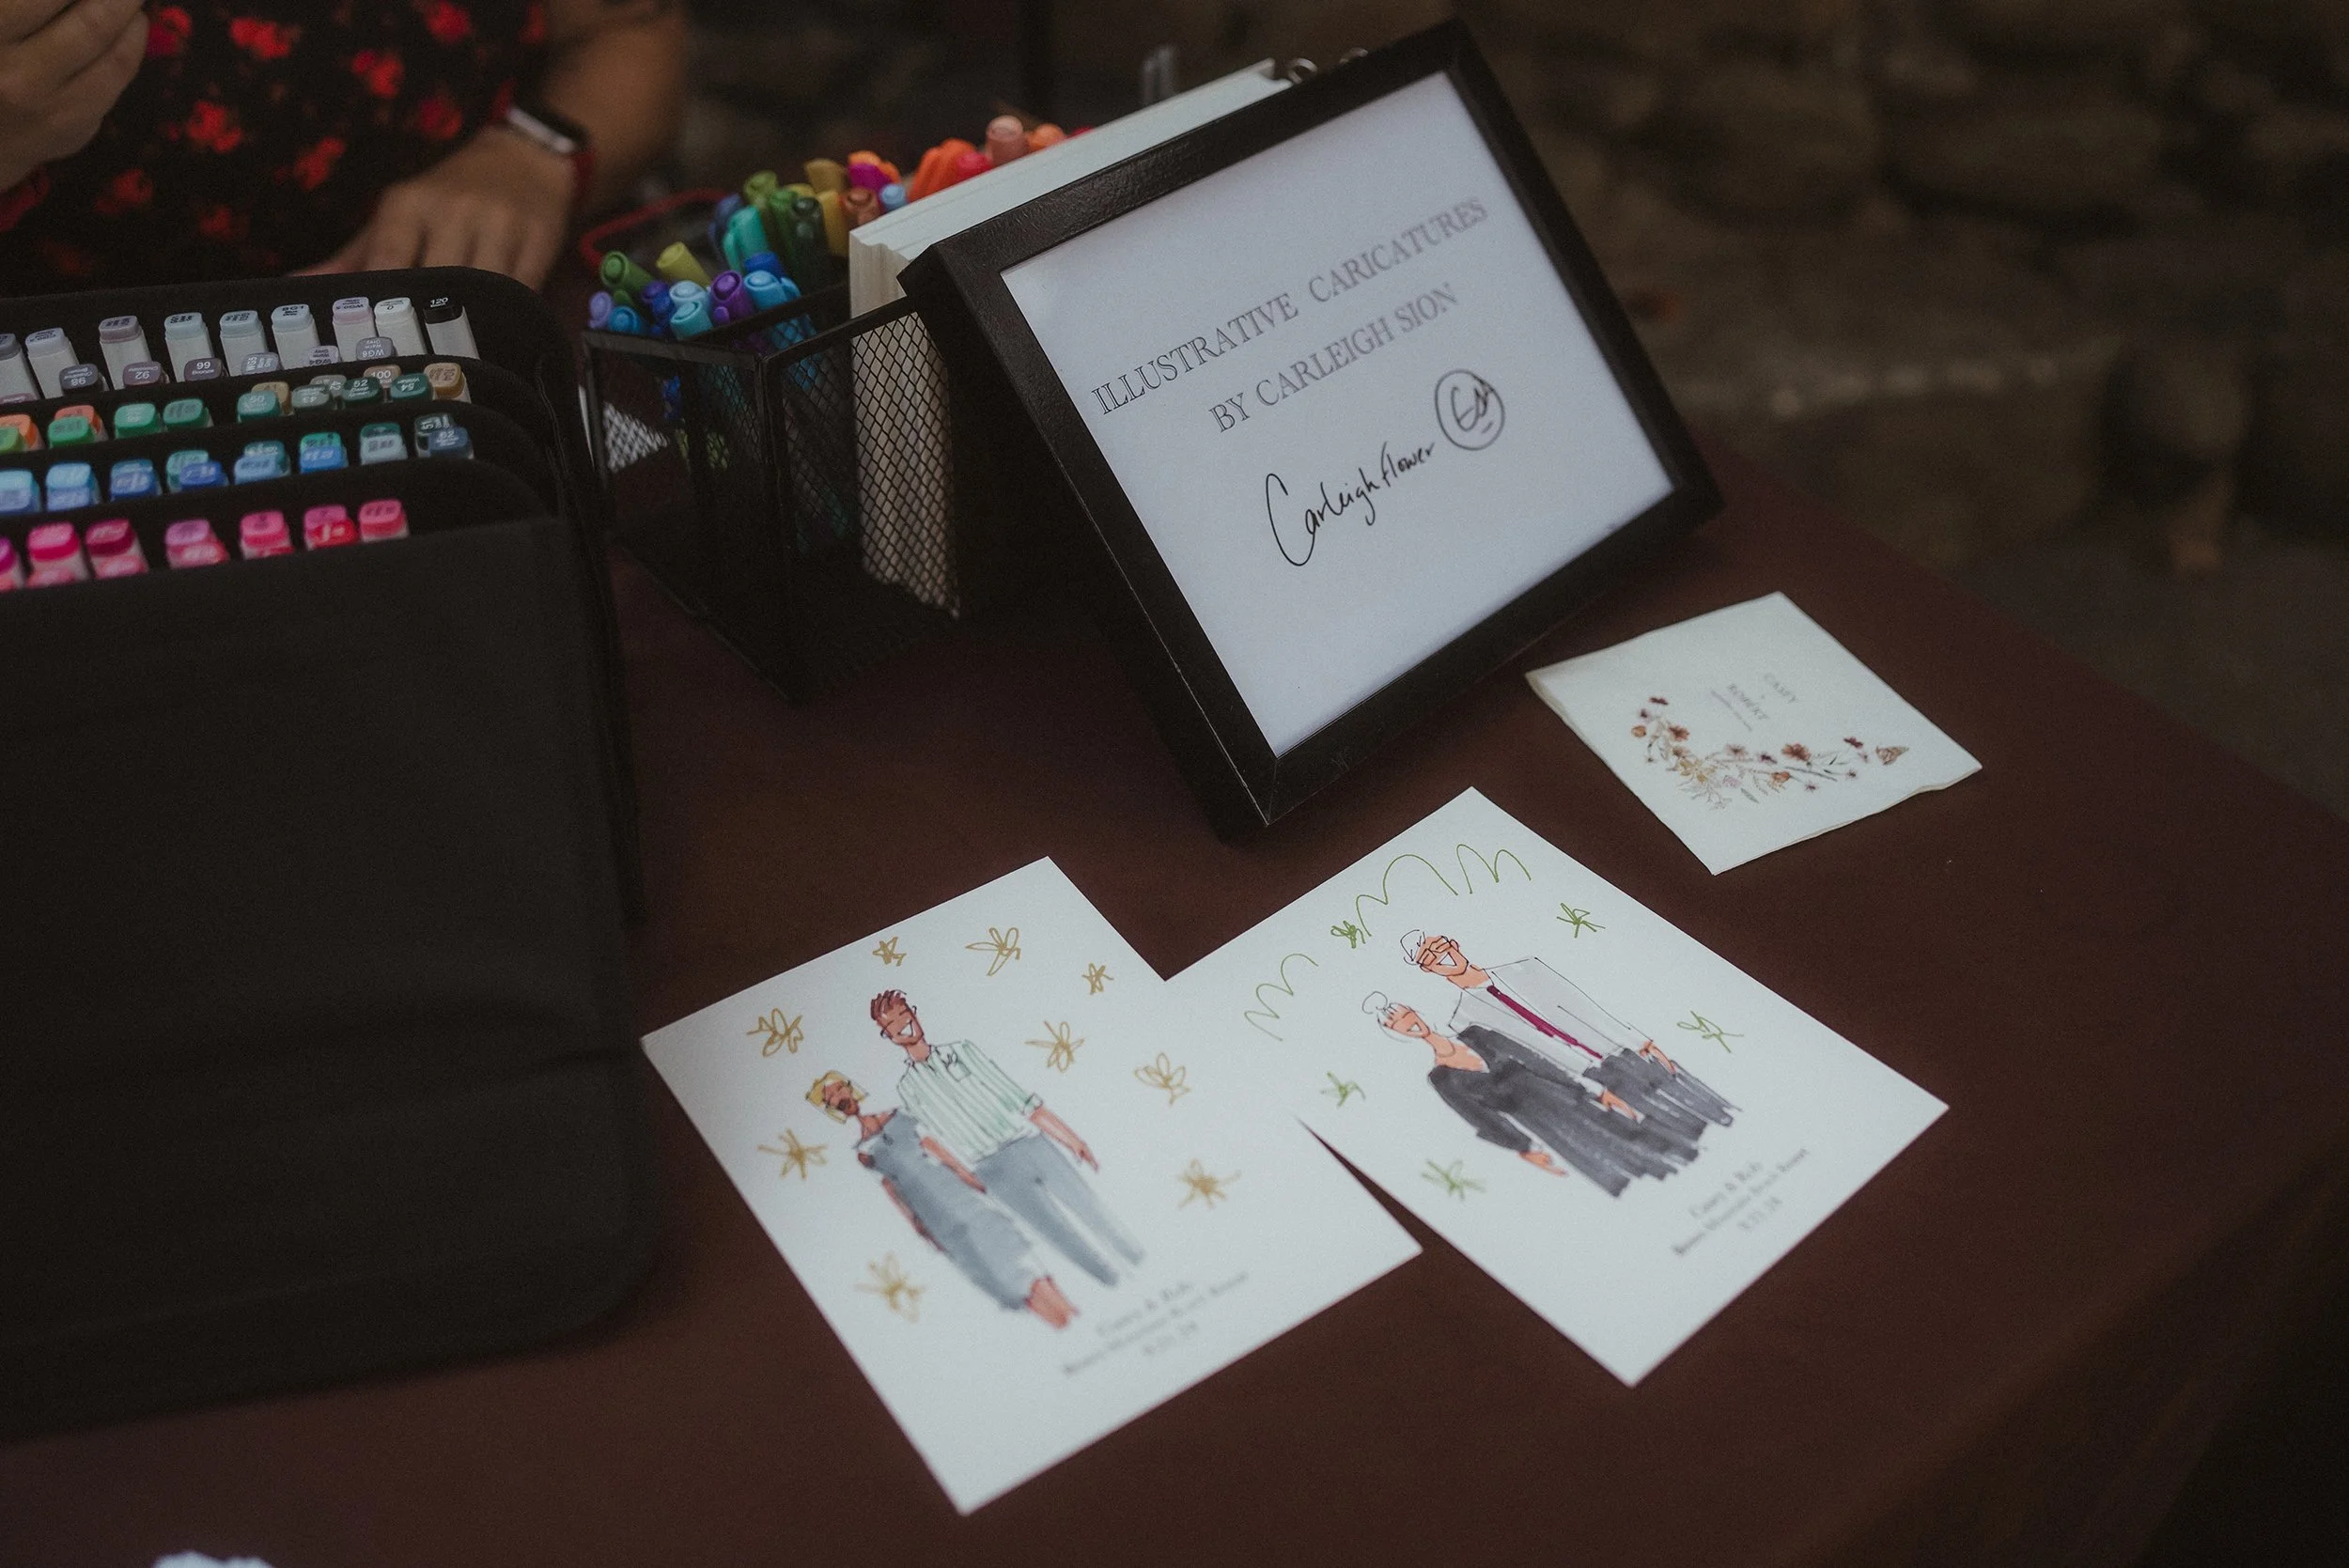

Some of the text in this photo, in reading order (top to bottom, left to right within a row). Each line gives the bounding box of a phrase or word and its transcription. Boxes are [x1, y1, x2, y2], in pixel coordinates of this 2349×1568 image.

[429, 297, 449, 306] 120
[1090, 292, 1300, 416] ILLUSTRATIVE
[1307, 195, 1489, 303] CARICATURES
[362, 349, 384, 357] WG8
[1207, 284, 1459, 434] BY CARLEIGH SION
[195, 361, 211, 370] 99
[134, 371, 150, 380] 92
[371, 370, 392, 380] 100
[70, 377, 86, 386] 98
[1264, 465, 1382, 567] Carleigh
